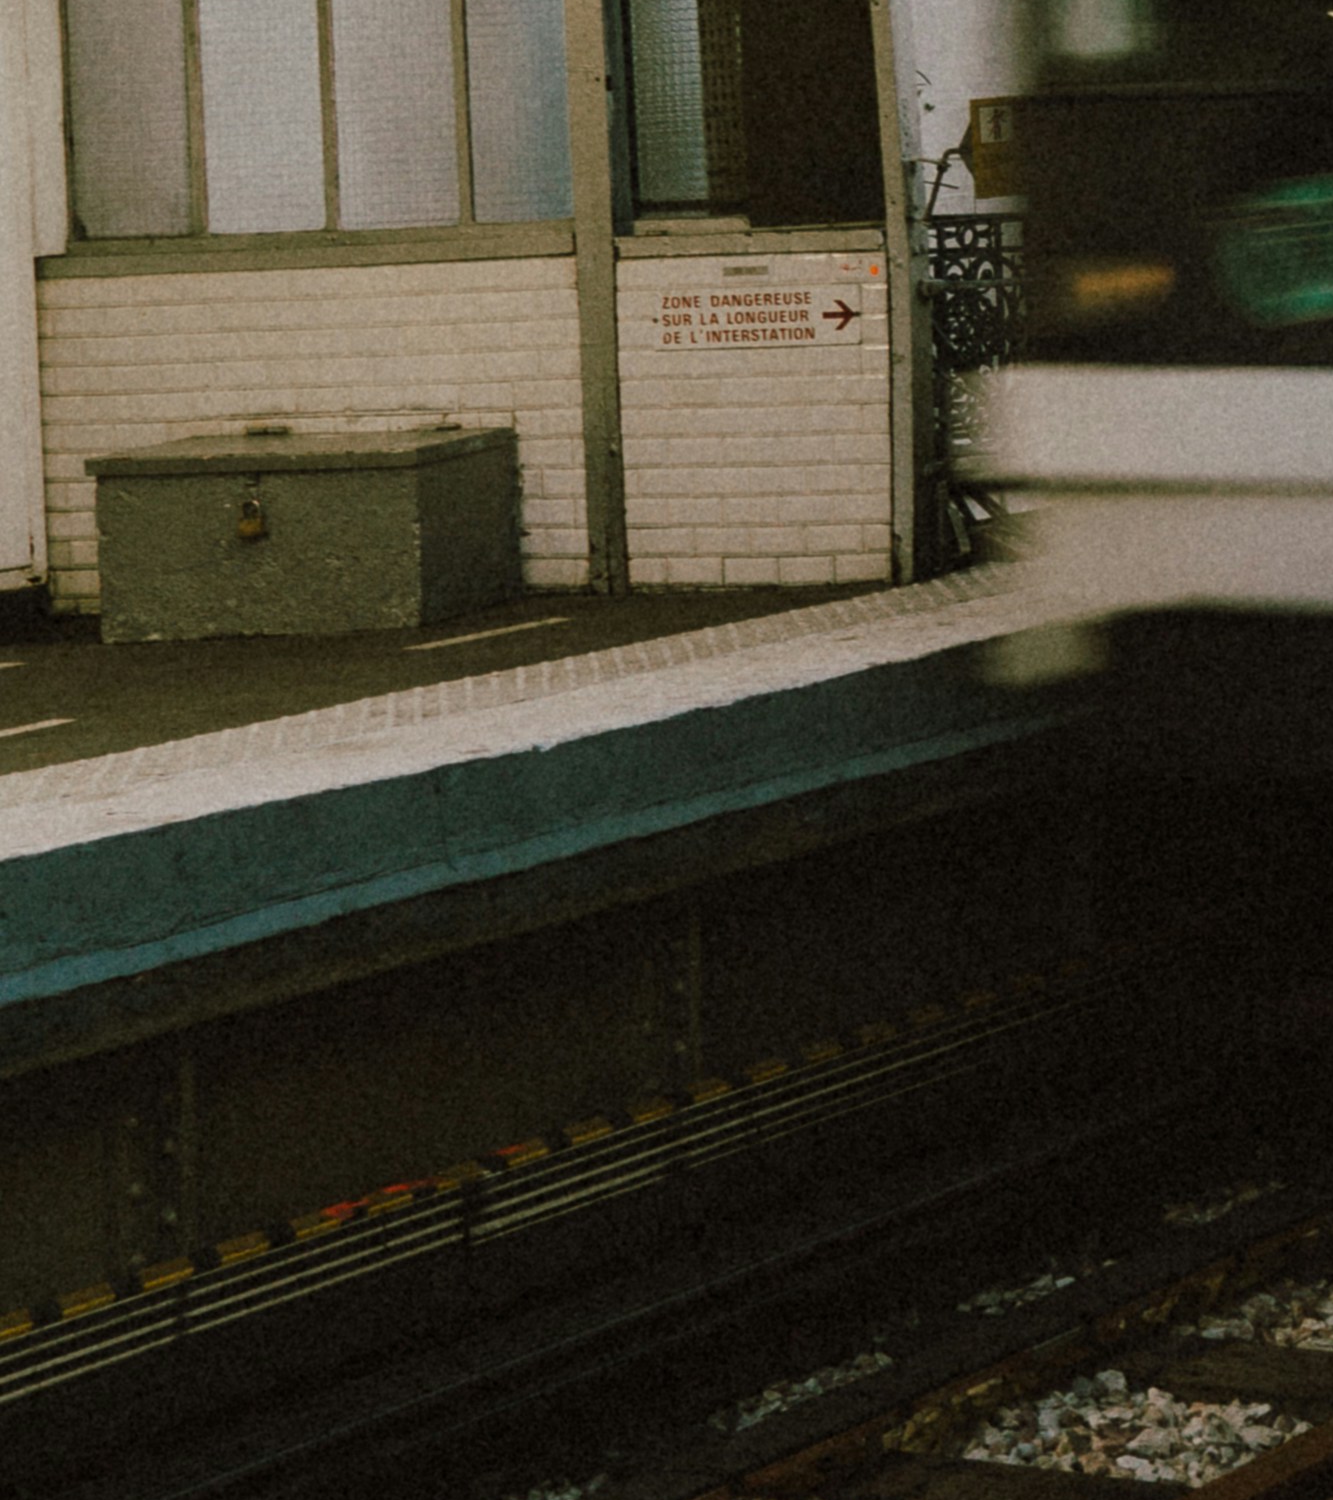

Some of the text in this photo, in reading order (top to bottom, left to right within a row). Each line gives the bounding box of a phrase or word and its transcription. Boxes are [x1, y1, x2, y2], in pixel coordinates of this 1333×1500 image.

[662, 292, 811, 309] ZONE DANGEREUSE
[662, 310, 809, 327] SUR LA LONGUEUR
[663, 327, 815, 344] DE L'INTERSTATION
